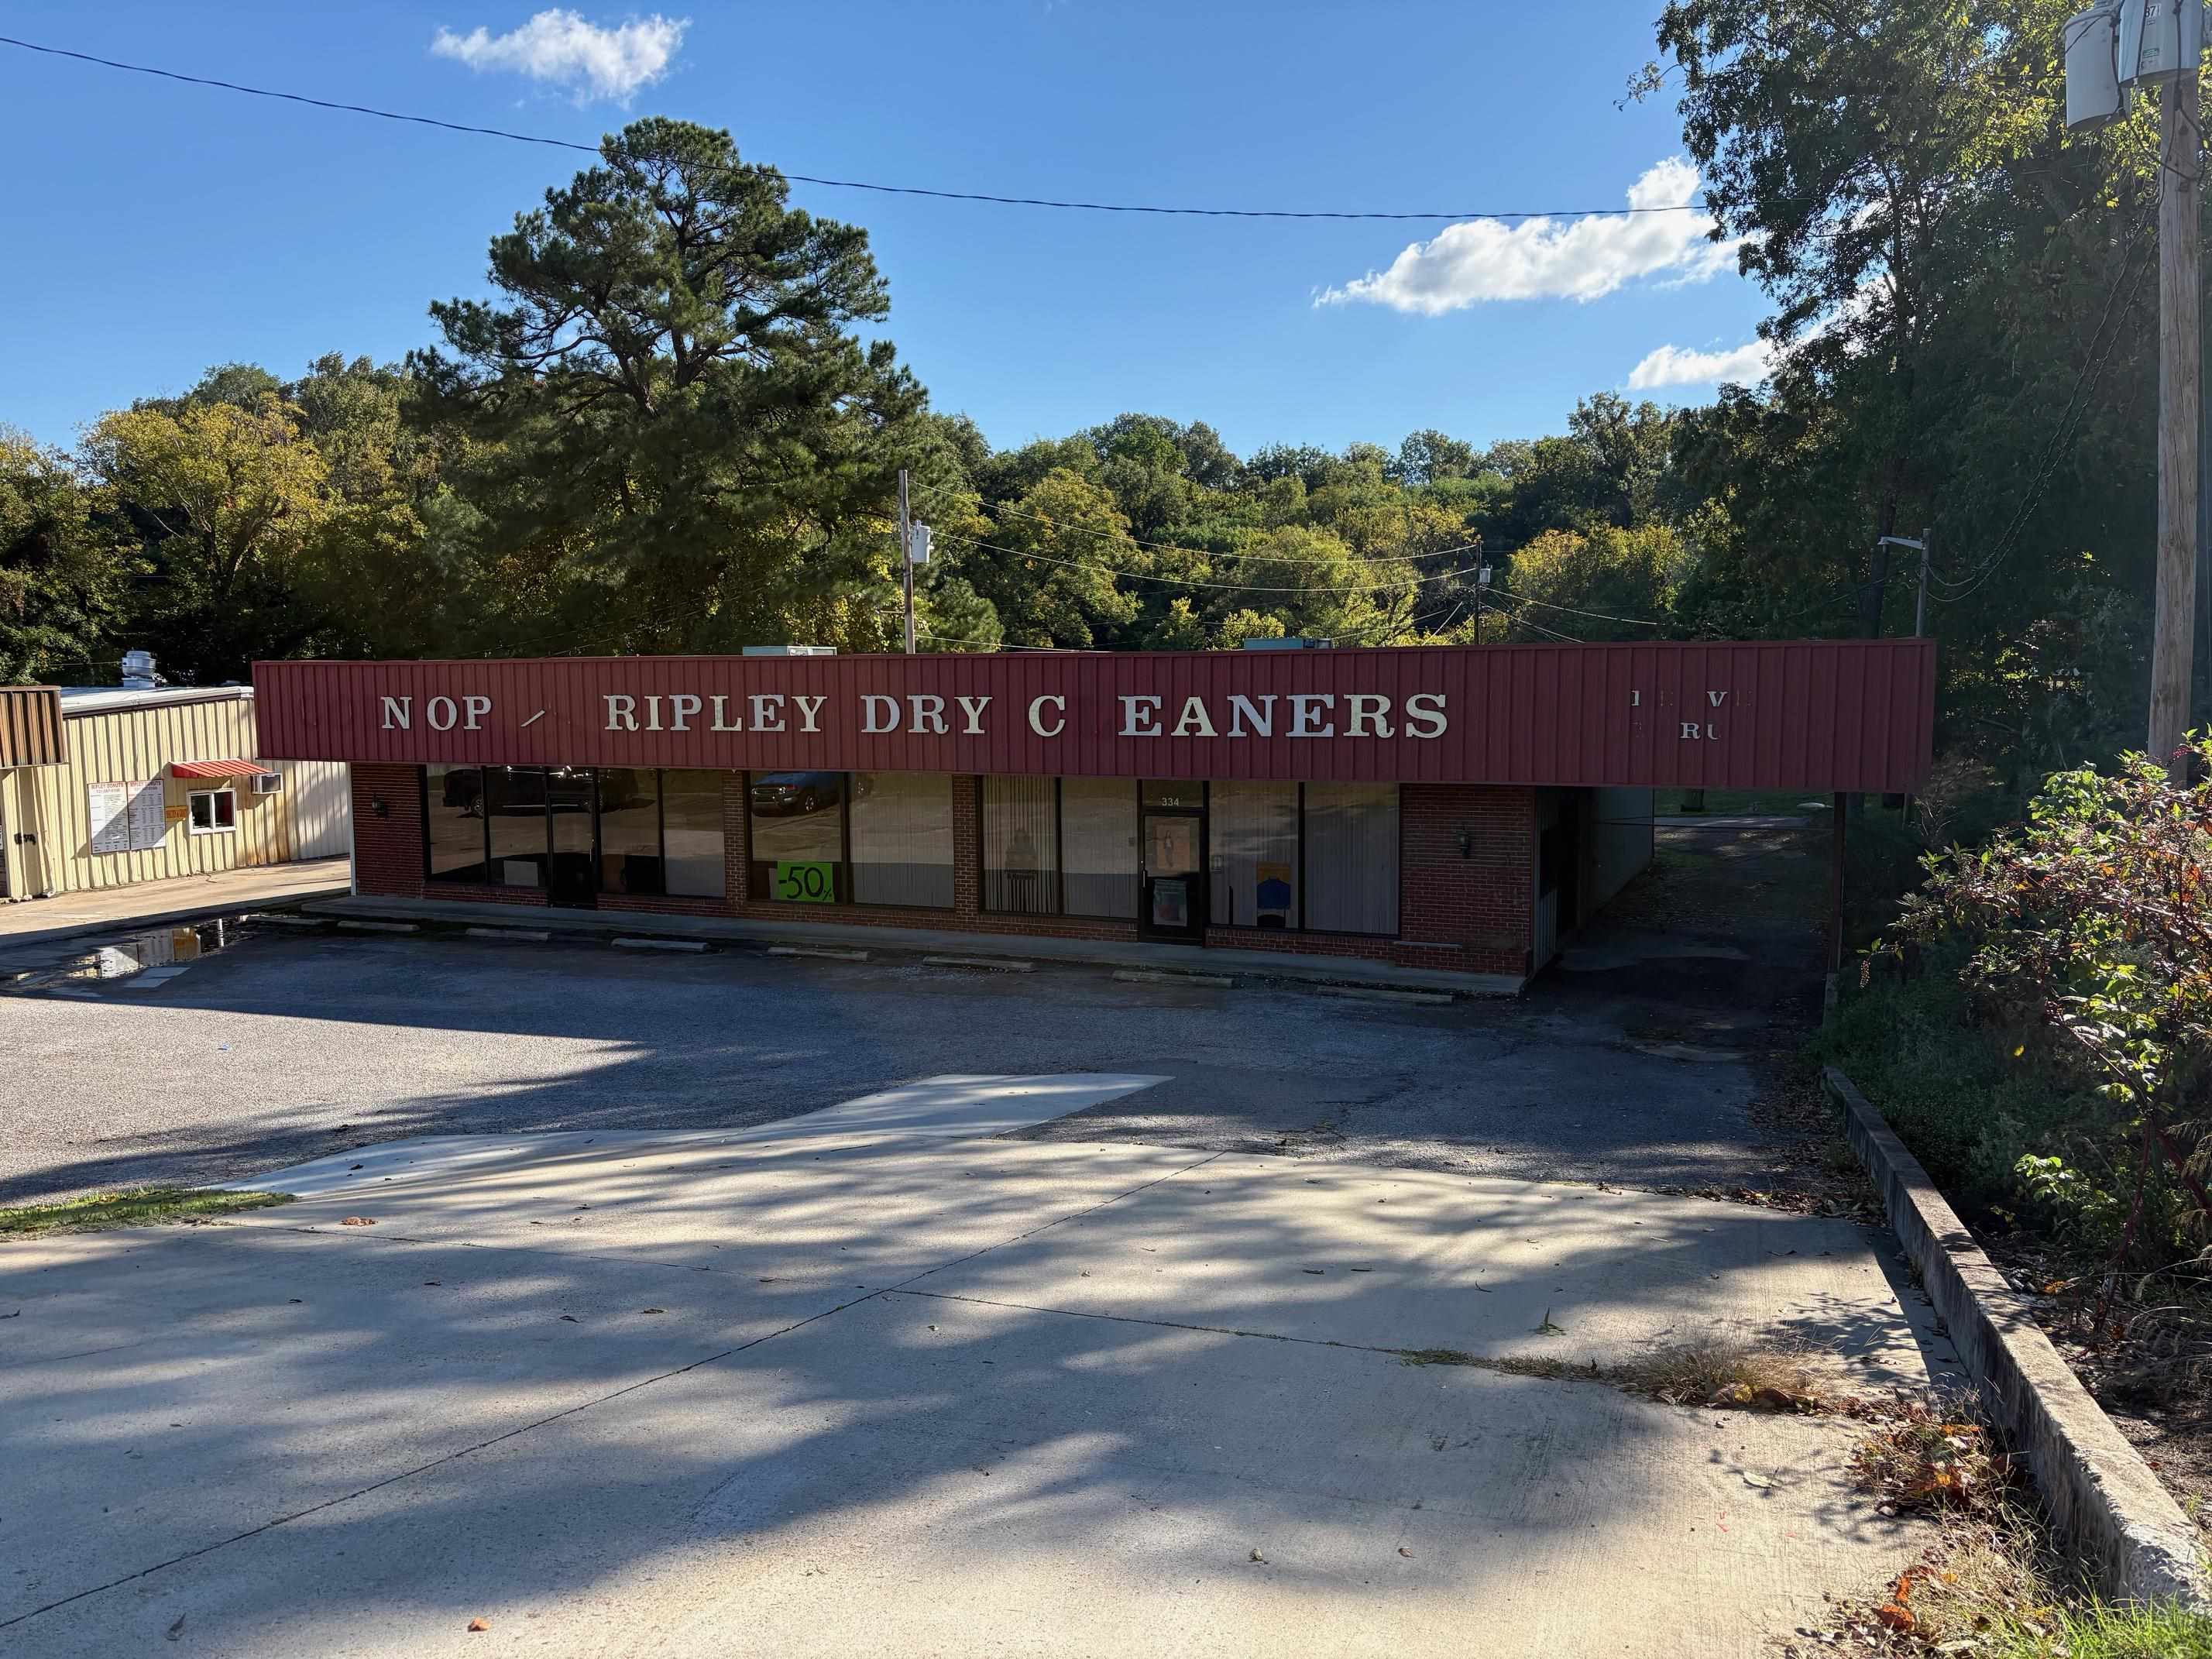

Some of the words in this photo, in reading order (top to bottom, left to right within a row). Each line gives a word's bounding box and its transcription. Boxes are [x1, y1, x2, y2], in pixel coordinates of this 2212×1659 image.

[603, 694, 827, 733] RIPLEY
[860, 695, 993, 734] DRY
[1162, 798, 1180, 806] 334
